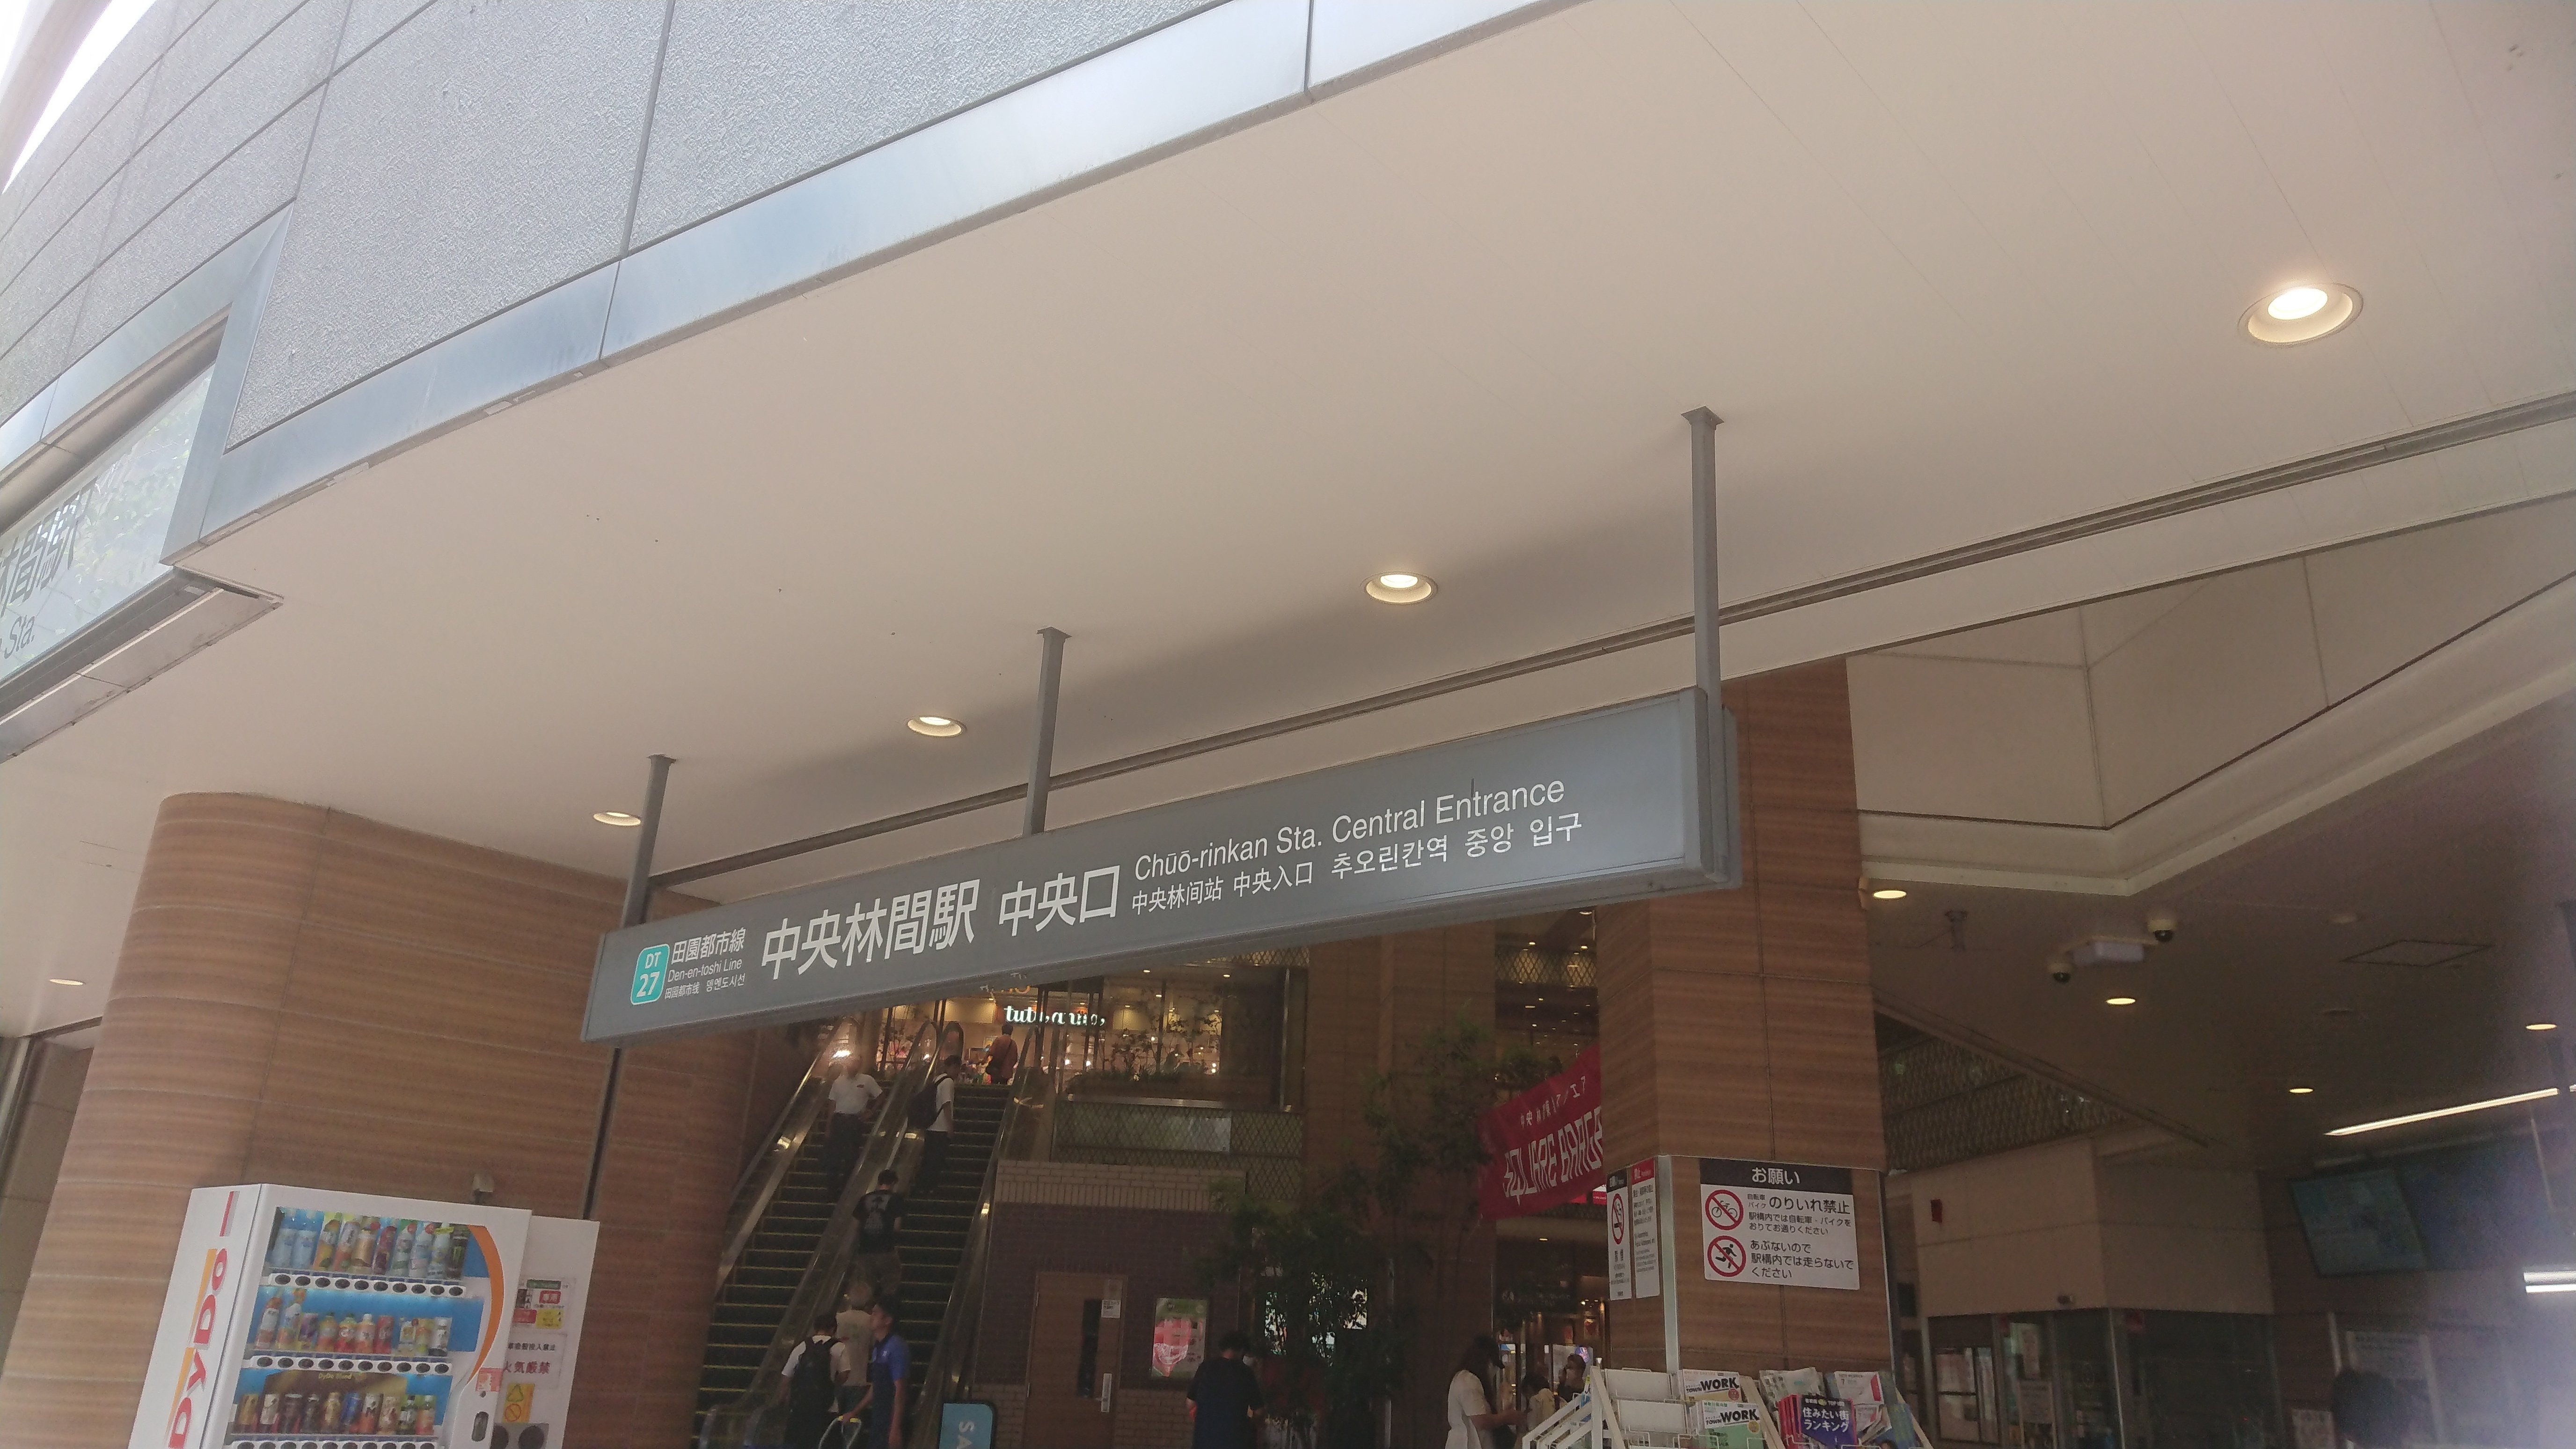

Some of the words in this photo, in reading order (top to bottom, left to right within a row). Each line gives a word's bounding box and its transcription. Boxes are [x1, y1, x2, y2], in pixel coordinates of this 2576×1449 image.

[1276, 827, 1322, 853] Sta.
[1332, 800, 1425, 843] Central
[1436, 780, 1565, 824] Entrance
[1332, 835, 1447, 879] 추오린칸역
[1464, 823, 1514, 858] 중앙
[1530, 812, 1582, 847] 입구
[1132, 876, 1224, 915] 中央林间站
[1233, 862, 1313, 897] 中央入口
[761, 879, 980, 980] 中央林間駅
[999, 865, 1120, 937] 中央口
[671, 927, 746, 965] 田園都市線
[645, 951, 662, 969] DT
[668, 960, 722, 982] Den-en-toshi
[724, 958, 742, 972] Line
[636, 971, 660, 997] 27
[1752, 1167, 1800, 1185] お願い
[1769, 1196, 1851, 1215] のりいれ禁止
[1749, 1222, 1828, 1235] おりてお通りください
[1750, 1240, 1811, 1254] あぶないので
[1751, 1253, 1854, 1269] 駅構内では走らないで
[1752, 1267, 1792, 1279] ください
[1700, 1377, 1739, 1391] WORK
[1720, 1409, 1760, 1422] WORK
[1802, 1407, 1849, 1421] 住みたい街
[1804, 1419, 1849, 1433] ランキング
